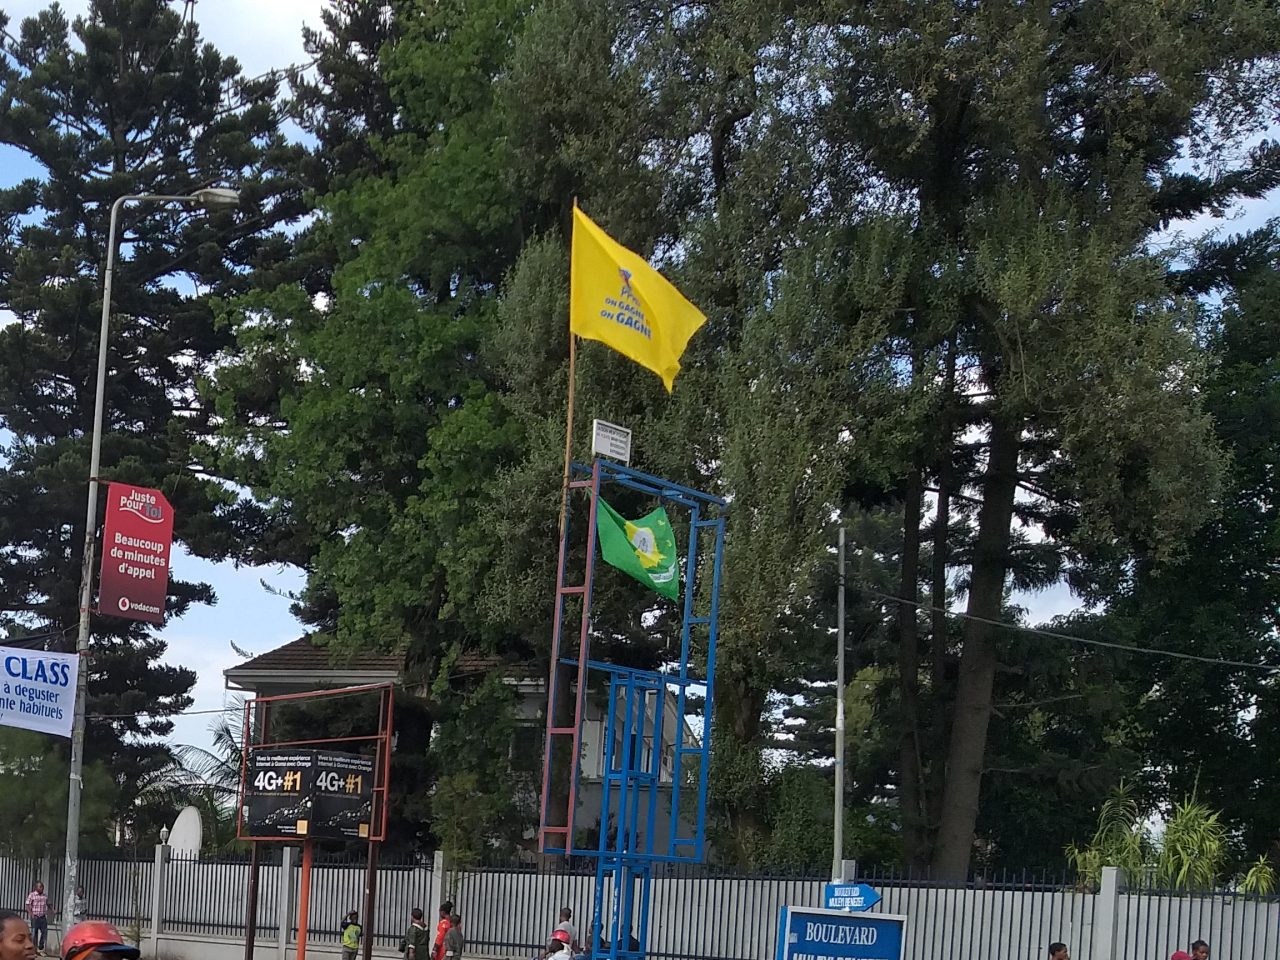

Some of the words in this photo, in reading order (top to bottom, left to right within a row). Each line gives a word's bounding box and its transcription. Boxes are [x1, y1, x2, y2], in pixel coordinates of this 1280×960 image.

[120, 496, 143, 510] Pour
[145, 503, 162, 518] Toi
[129, 490, 156, 504] Juste
[114, 532, 164, 554] Beaucoup
[110, 546, 123, 558] de
[124, 550, 166, 567] minutes
[130, 602, 160, 614] vodacom
[5, 656, 70, 687] CLASS
[19, 699, 63, 720] habituels
[805, 921, 878, 946] BOULEVARD
